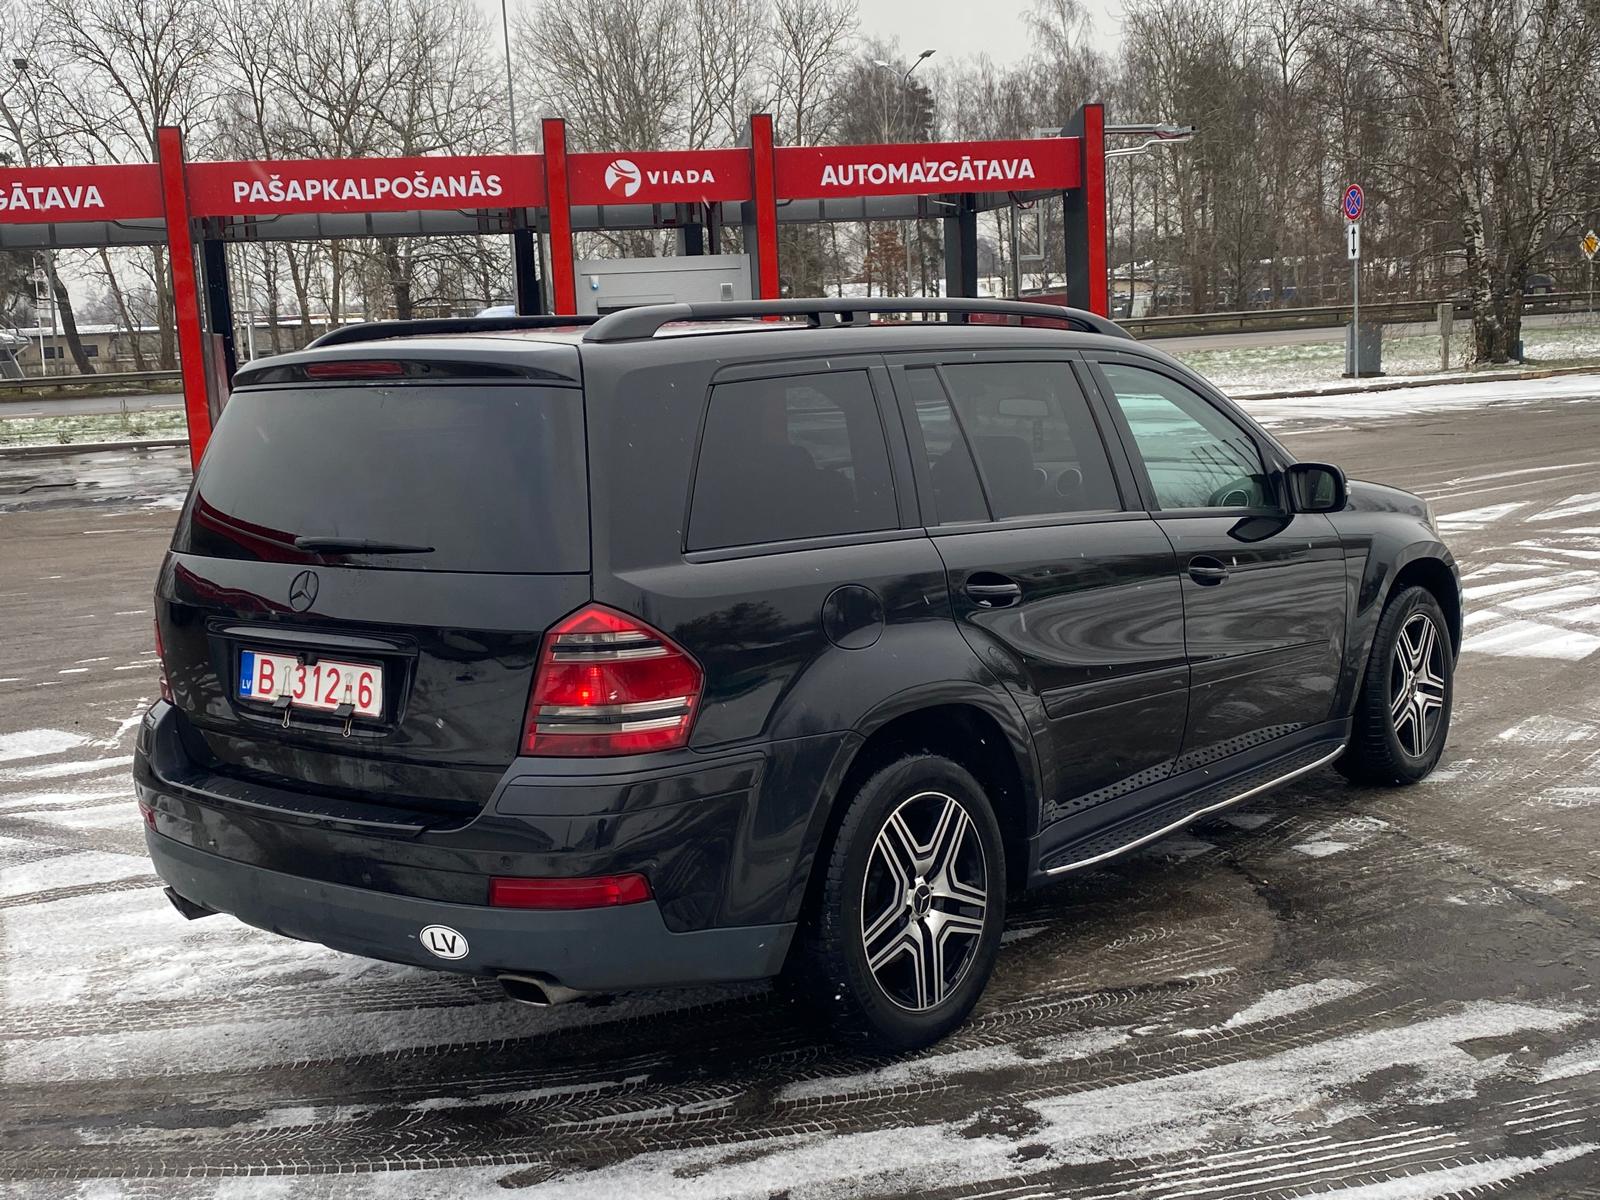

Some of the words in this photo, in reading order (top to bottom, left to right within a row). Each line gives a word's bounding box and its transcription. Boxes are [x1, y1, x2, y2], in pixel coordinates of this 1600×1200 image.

[646, 169, 715, 185] VIADA
[820, 156, 1035, 186] AUTOMAZGĀTAVA
[233, 170, 503, 203] PAŠAPKALPOŠANĀS
[241, 679, 252, 689] LV
[429, 931, 457, 954] LV
